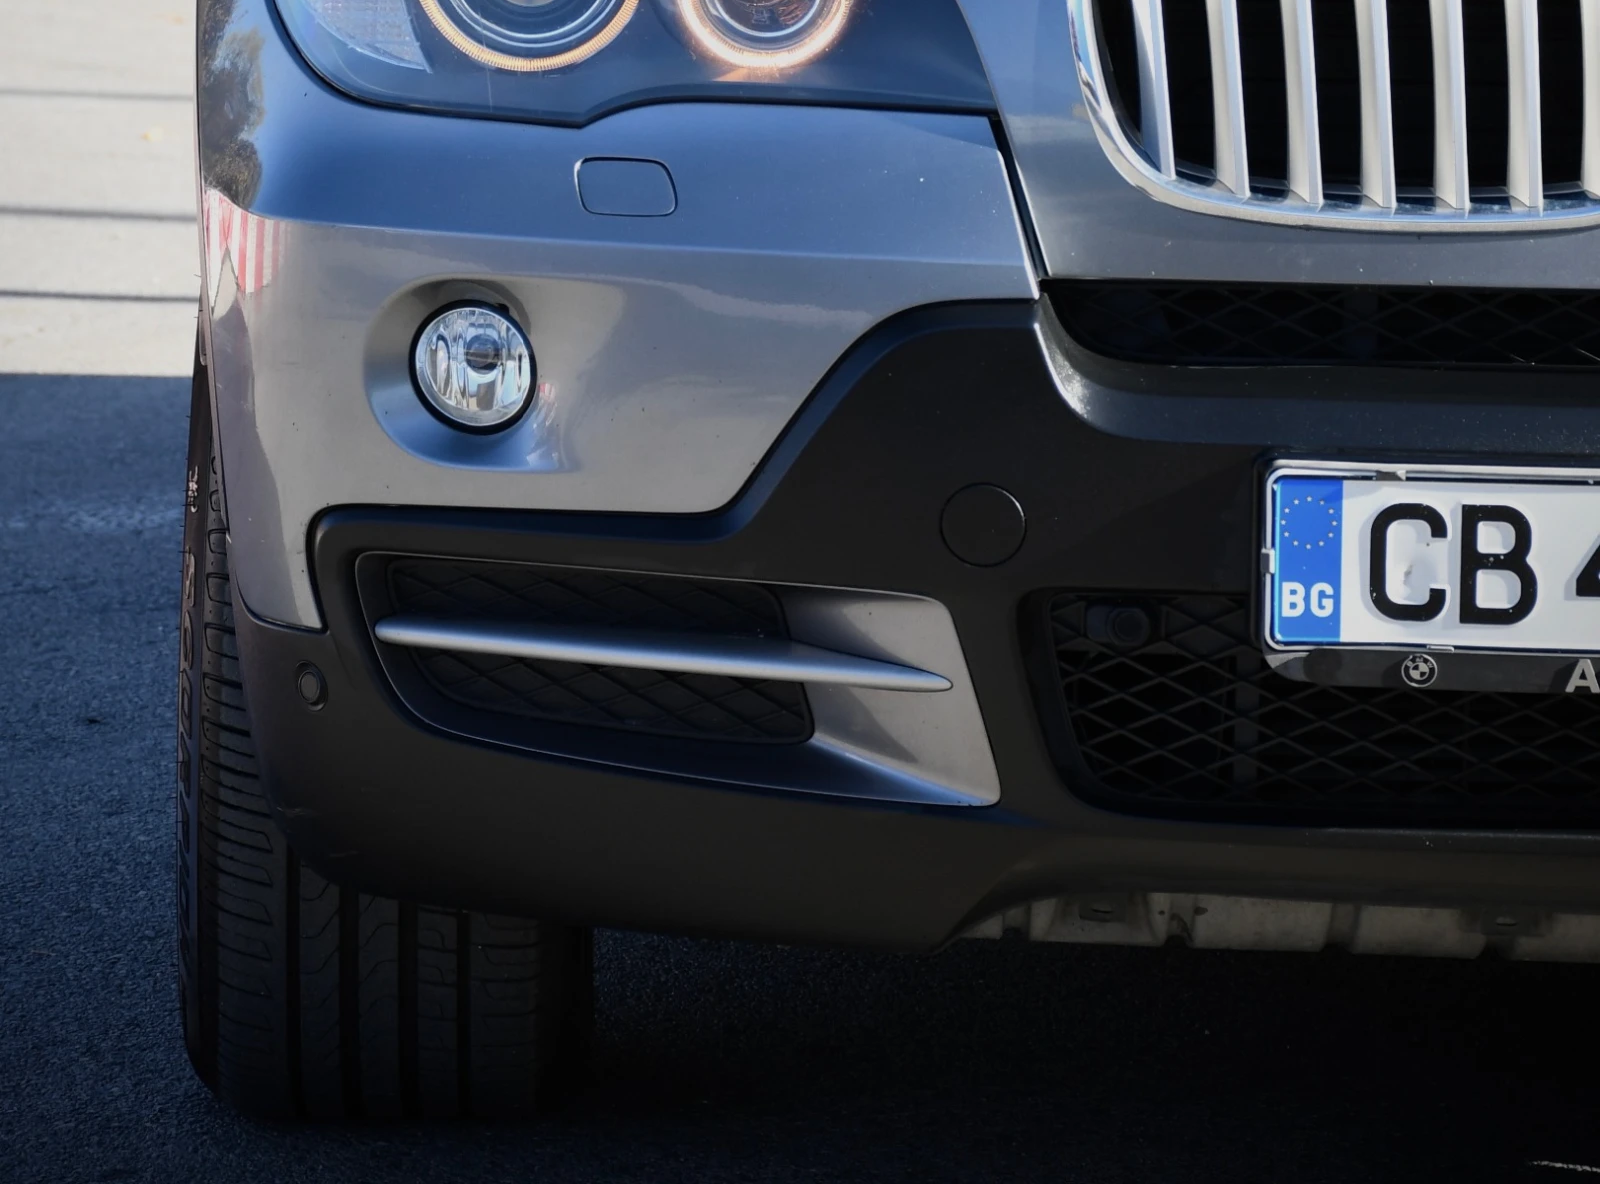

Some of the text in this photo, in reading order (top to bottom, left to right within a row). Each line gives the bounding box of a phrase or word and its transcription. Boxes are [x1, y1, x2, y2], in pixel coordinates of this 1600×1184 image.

[1369, 502, 1538, 625] CB
[1281, 582, 1334, 617] BG
[1565, 658, 1600, 693] A
